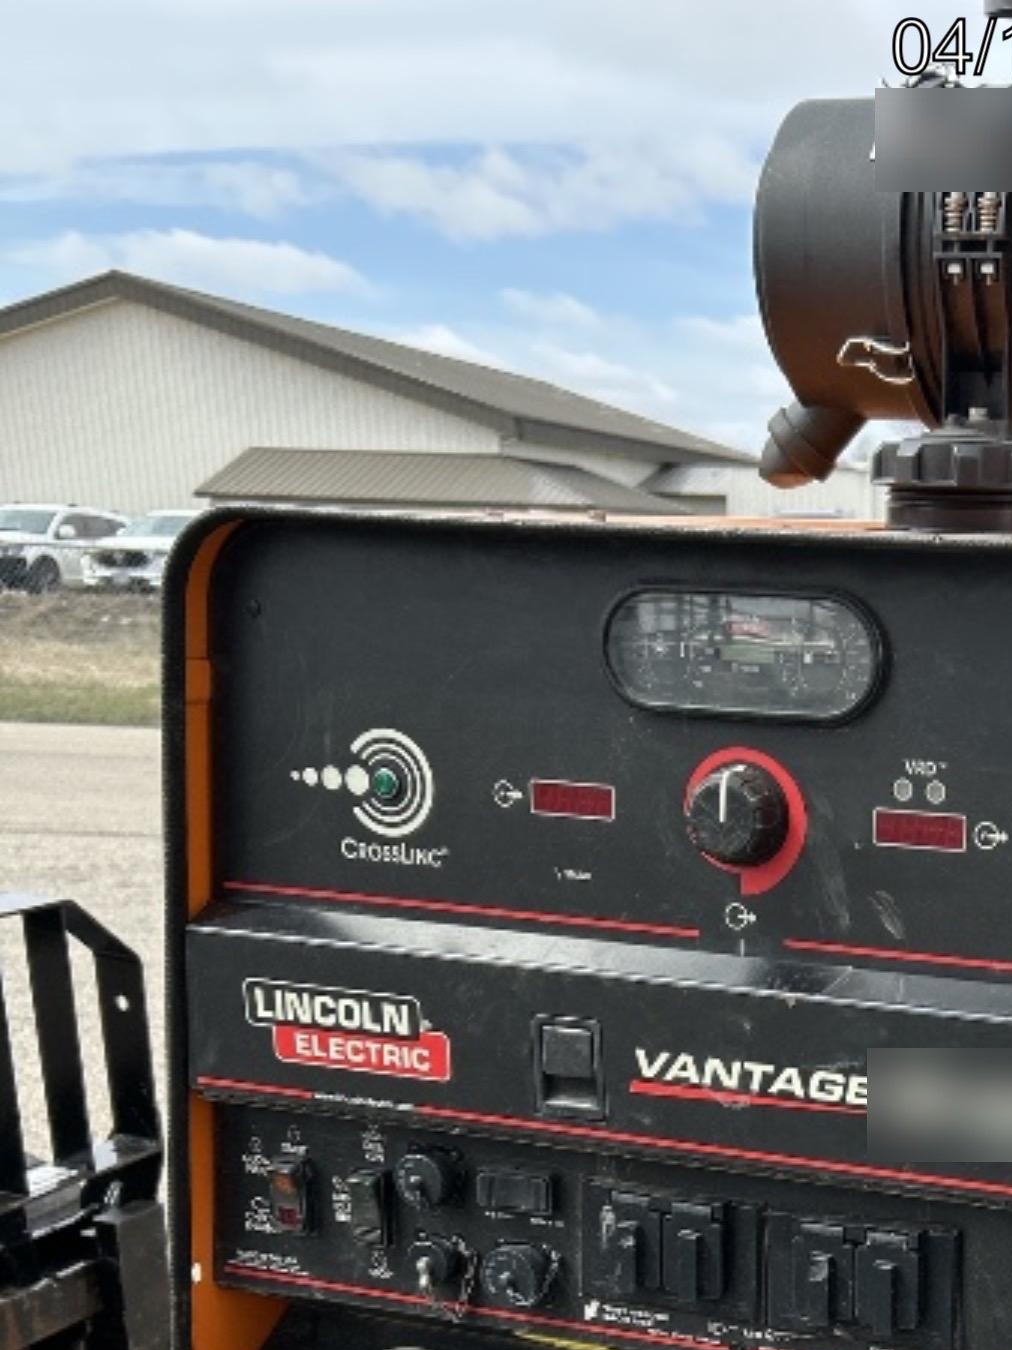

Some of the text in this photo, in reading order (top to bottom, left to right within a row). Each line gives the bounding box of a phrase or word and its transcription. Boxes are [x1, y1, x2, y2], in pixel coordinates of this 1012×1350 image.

[254, 987, 411, 1035] LINCOLN
[294, 1032, 432, 1072] ELECTRIC
[634, 1048, 867, 1105] VANTAGE
